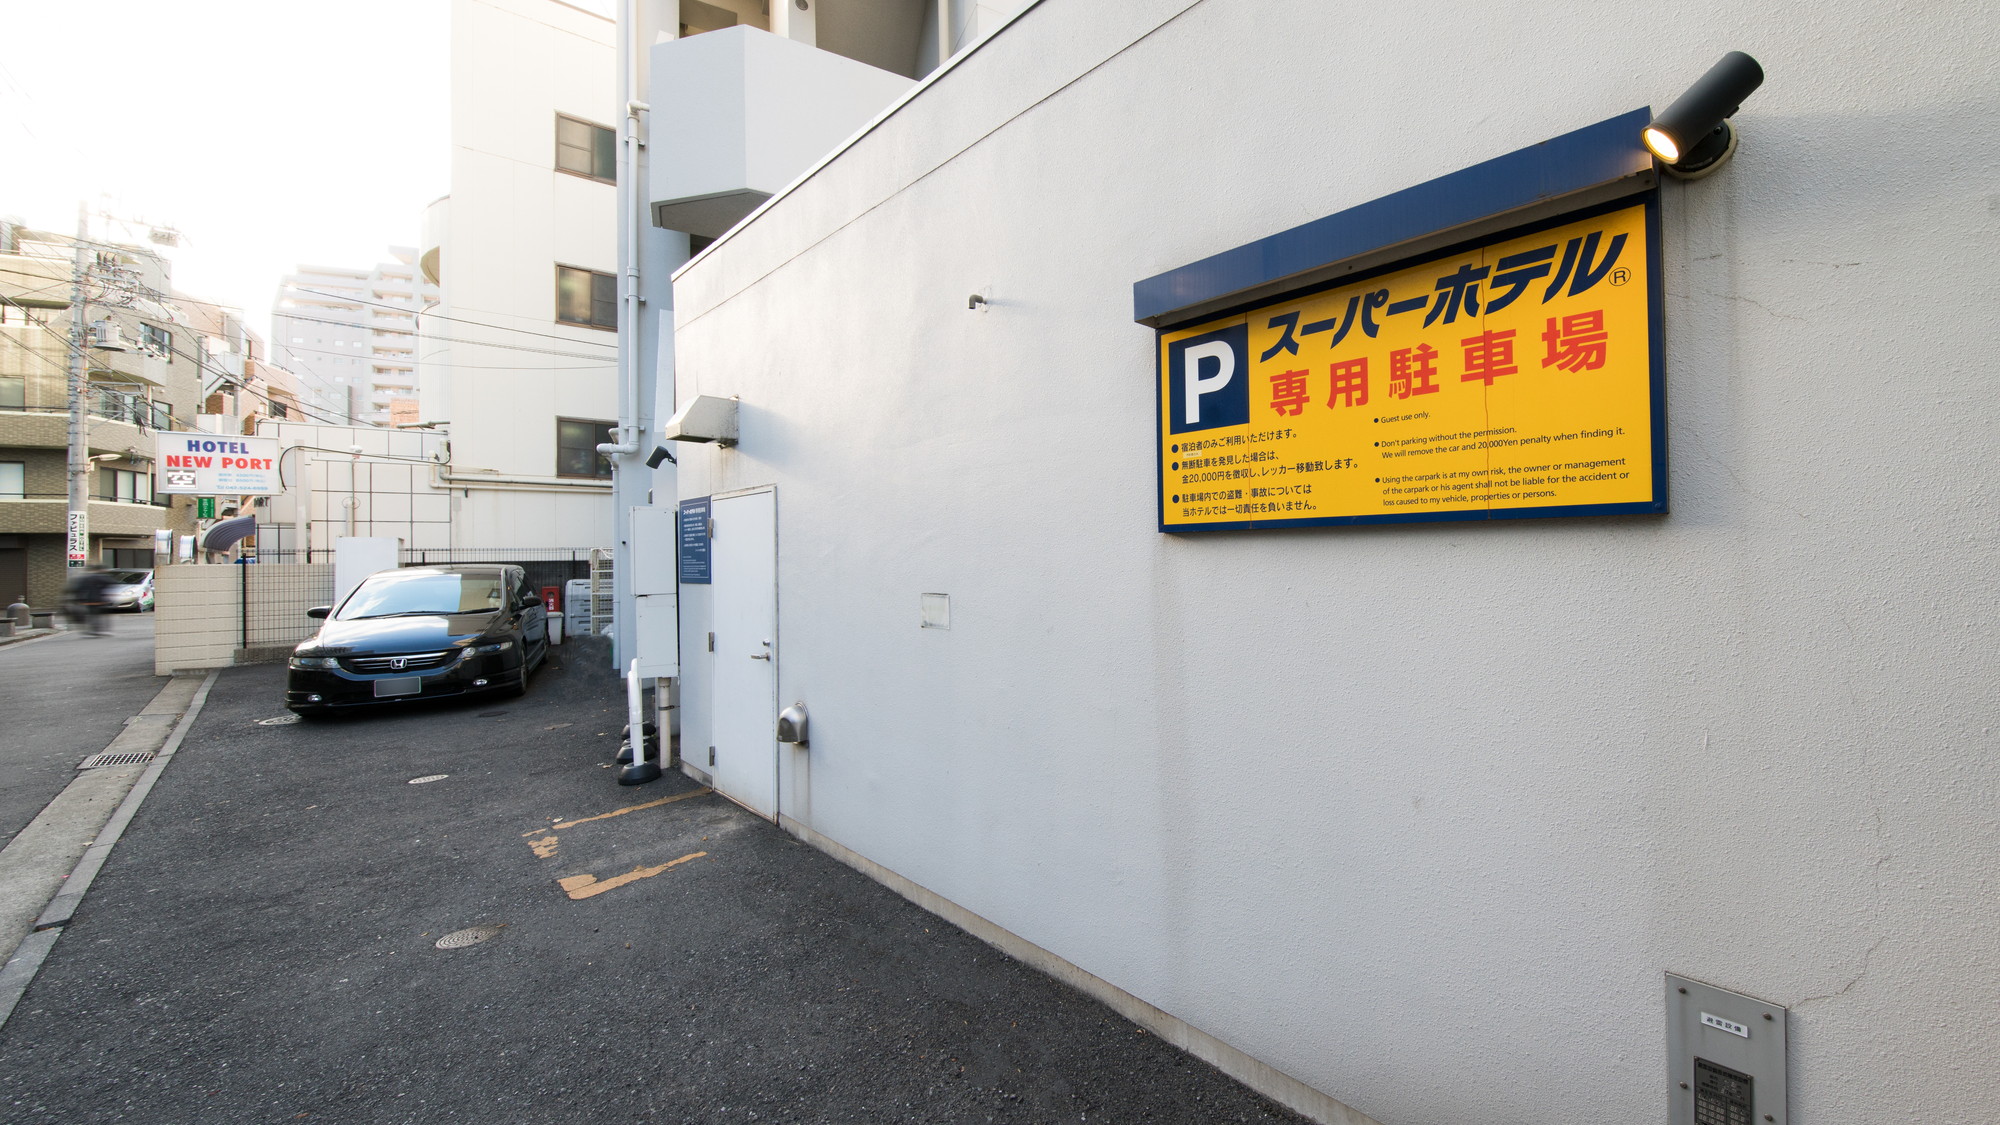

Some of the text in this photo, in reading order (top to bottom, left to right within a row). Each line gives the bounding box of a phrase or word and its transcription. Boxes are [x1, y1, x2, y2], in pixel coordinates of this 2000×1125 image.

[1259, 230, 1629, 363] スーパーホテル
[1269, 309, 1608, 417] 専用駐車場
[1184, 340, 1235, 424] P
[1381, 415, 1400, 423] Guest
[1414, 411, 1430, 419] only.
[1181, 428, 1297, 452] 宿泊者のみご利用いただけます。
[1401, 437, 1427, 446] parking
[1429, 434, 1457, 442] without
[1474, 427, 1516, 439] permission.
[1408, 448, 1433, 456] remove
[1462, 442, 1476, 450] and
[1478, 439, 1518, 449] 20,000Yen
[1520, 434, 1551, 446] penalty
[1553, 432, 1578, 441] when
[1581, 429, 1613, 438] finding
[1616, 427, 1625, 435] it.
[187, 440, 249, 454] HOTEL
[166, 455, 272, 470] NEW PORT
[1181, 450, 1279, 470] 無断駐車を発見した場合は、
[167, 470, 196, 488] 空
[1382, 476, 1400, 484] Using
[1415, 472, 1440, 482] carpark
[1459, 471, 1470, 479] my
[1491, 467, 1506, 475] risk,
[1564, 458, 1626, 469] management
[1404, 485, 1429, 494] carpark
[1452, 482, 1473, 491] agent
[1475, 480, 1492, 488] shall
[1494, 479, 1508, 487] not
[1522, 477, 1545, 486] liable
[1562, 474, 1576, 482] the
[1579, 472, 1617, 482] accident
[1619, 471, 1630, 479] or
[1182, 484, 1312, 503] 駐車場内での盗難・事故については
[1396, 497, 1418, 505] caused
[1430, 496, 1440, 504] my
[1442, 494, 1468, 503] vehicle,
[1471, 492, 1510, 503] properties
[1522, 490, 1557, 500] persons.
[1182, 500, 1317, 517] 当ホテルでは一切責任を負いません。
